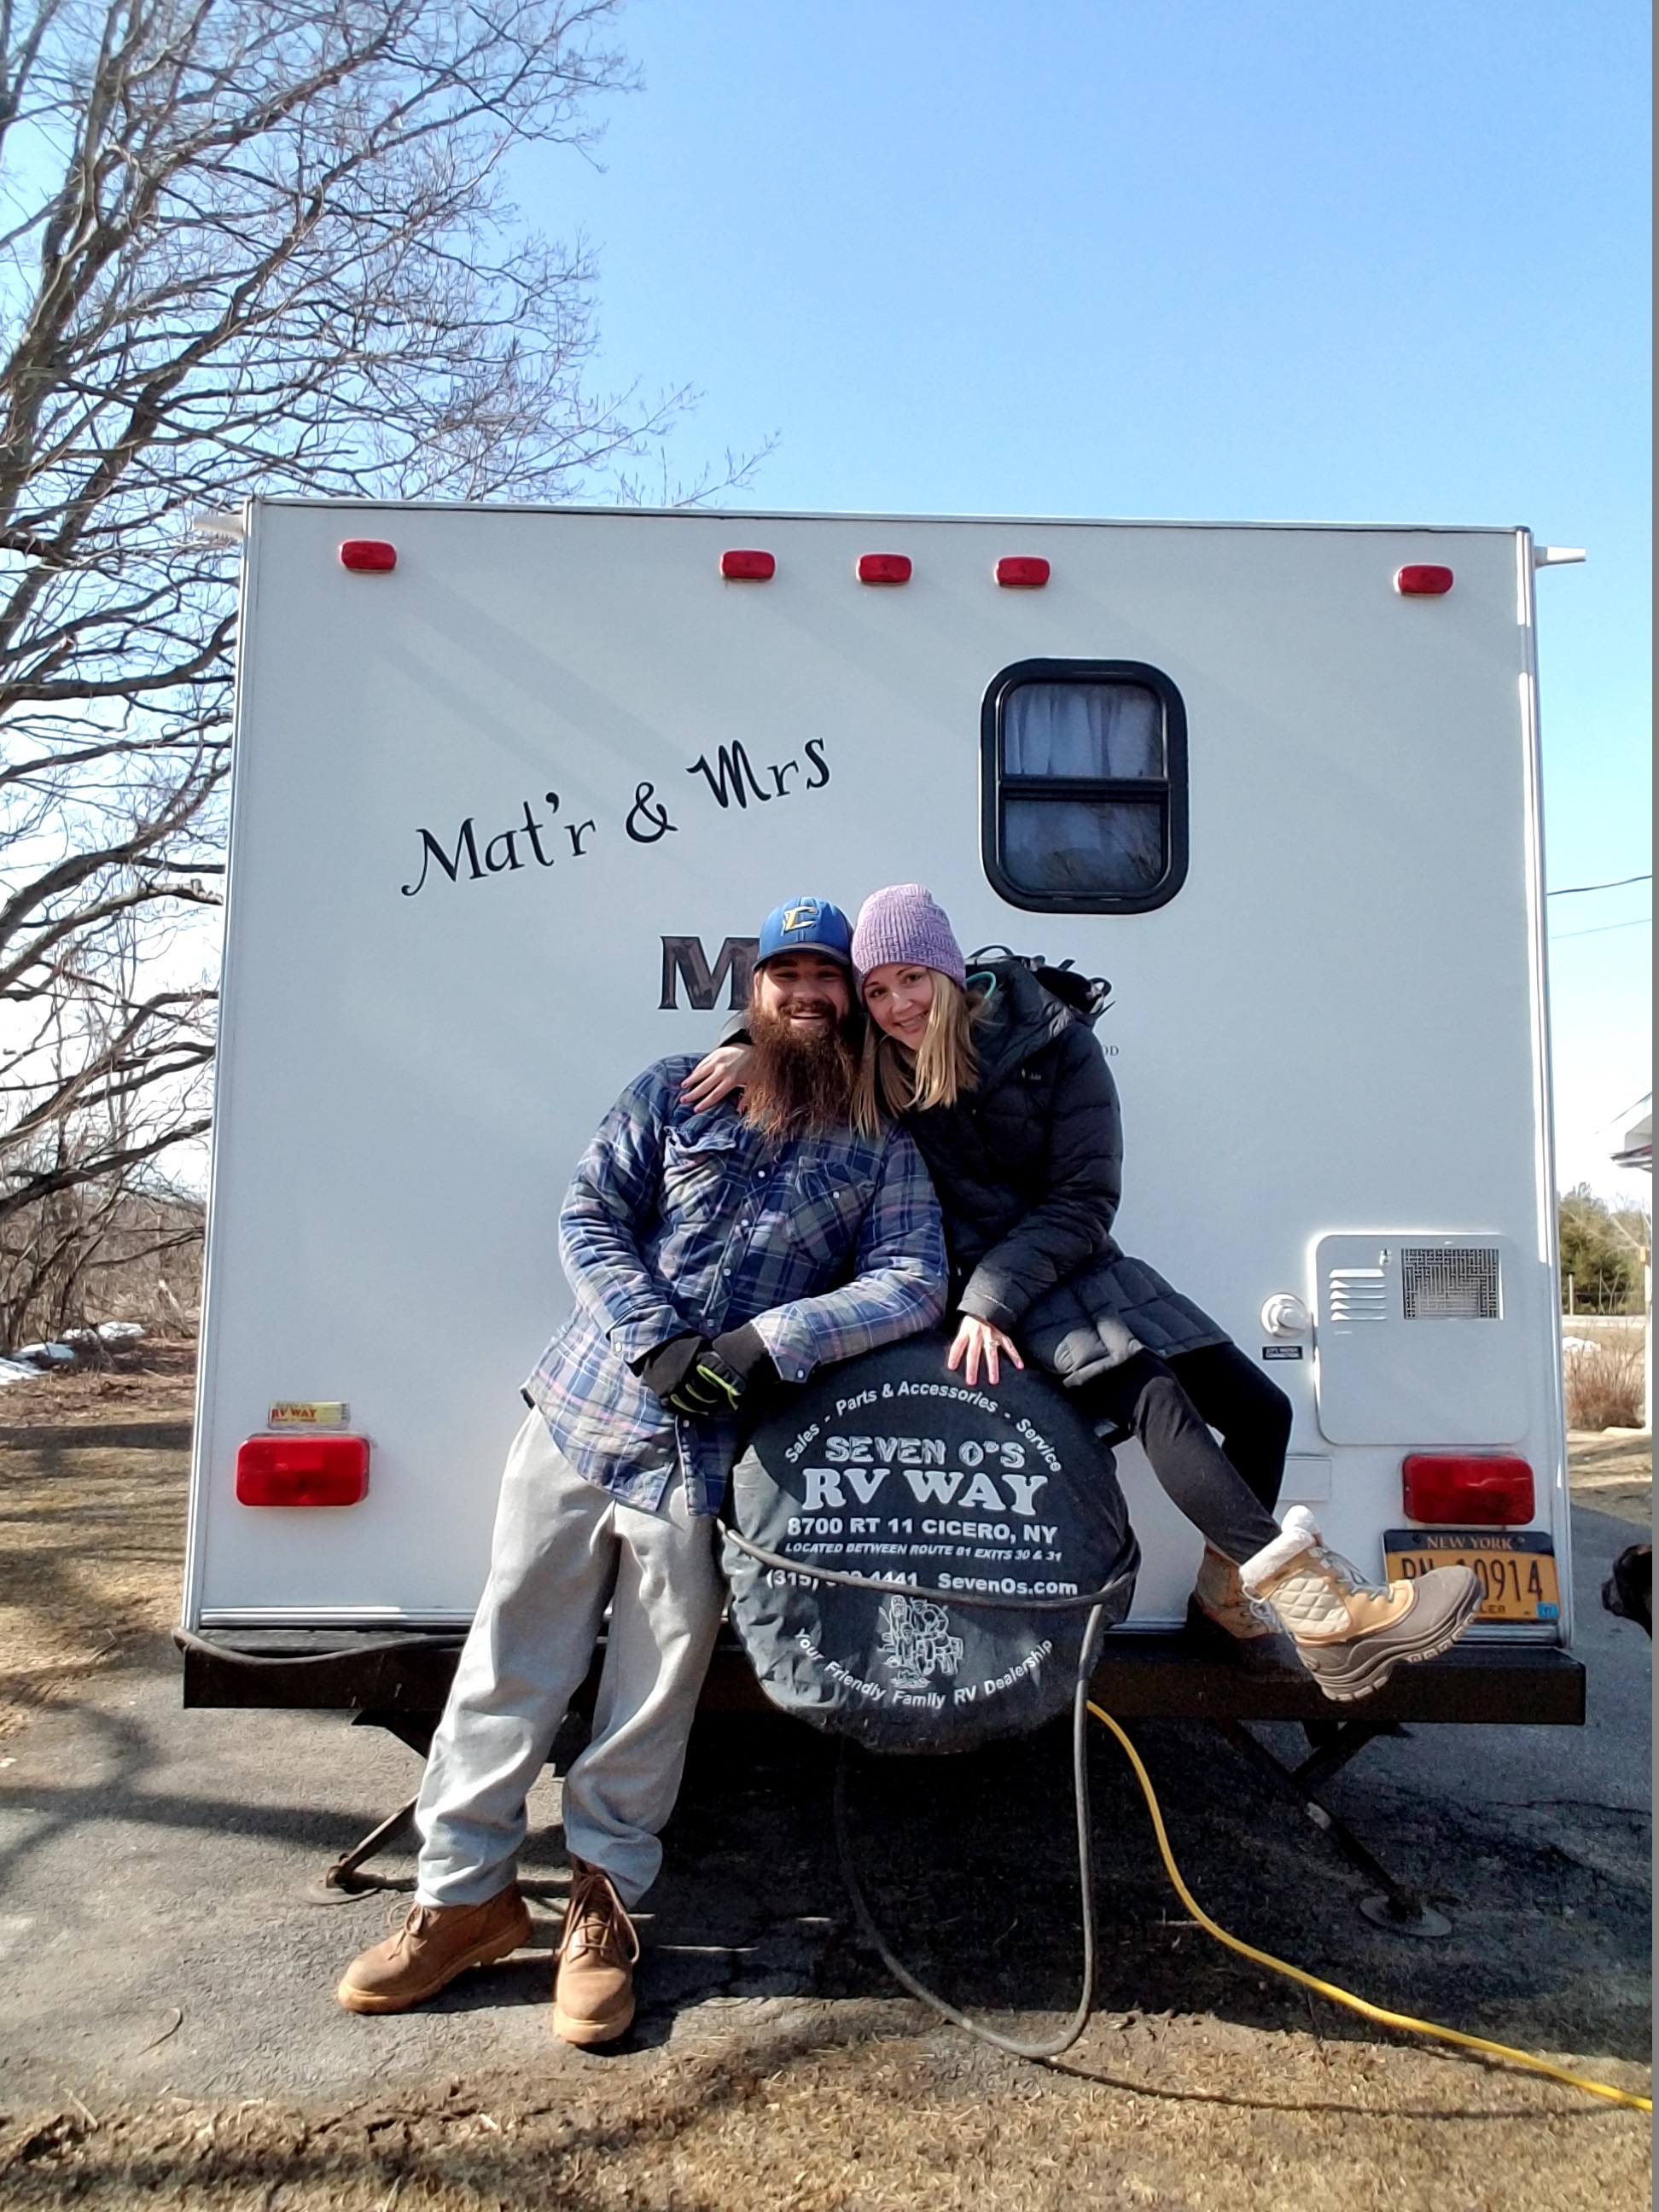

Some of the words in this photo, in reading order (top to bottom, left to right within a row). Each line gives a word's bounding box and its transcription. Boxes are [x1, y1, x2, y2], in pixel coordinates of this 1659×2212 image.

[401, 791, 597, 896] Mat'r
[626, 782, 679, 844] &
[686, 737, 831, 809] Mrs
[785, 1423, 819, 1463] Sales
[835, 1388, 877, 1417] Parts
[882, 1382, 894, 1398] &
[898, 1380, 998, 1412] Accessories
[1016, 1418, 1062, 1472] Service
[825, 1436, 946, 1464] SEVEN
[802, 1468, 890, 1510] RV
[903, 1470, 1048, 1516] WAY
[788, 1517, 843, 1535] 8700
[850, 1517, 881, 1534] RT
[888, 1518, 913, 1534] 11
[922, 1519, 1016, 1545] CICERO,
[1023, 1524, 1058, 1544] NY
[1426, 1536, 1466, 1549] NEW
[1471, 1536, 1513, 1550] YORK
[785, 1542, 844, 1554] LOCATED
[846, 1543, 908, 1555] BETWEEN
[910, 1545, 954, 1556] ROUTE
[975, 1548, 1013, 1561] EXITS
[1015, 1549, 1031, 1561] 30
[1033, 1550, 1043, 1560] &
[1045, 1551, 1062, 1562] 31
[938, 1572, 1079, 1596] SevenOs.com
[795, 1627, 826, 1661] Your
[824, 1661, 888, 1701] Friendly
[893, 1690, 946, 1709] Family
[954, 1685, 977, 1706] RV
[984, 1639, 1053, 1696] Dealership
